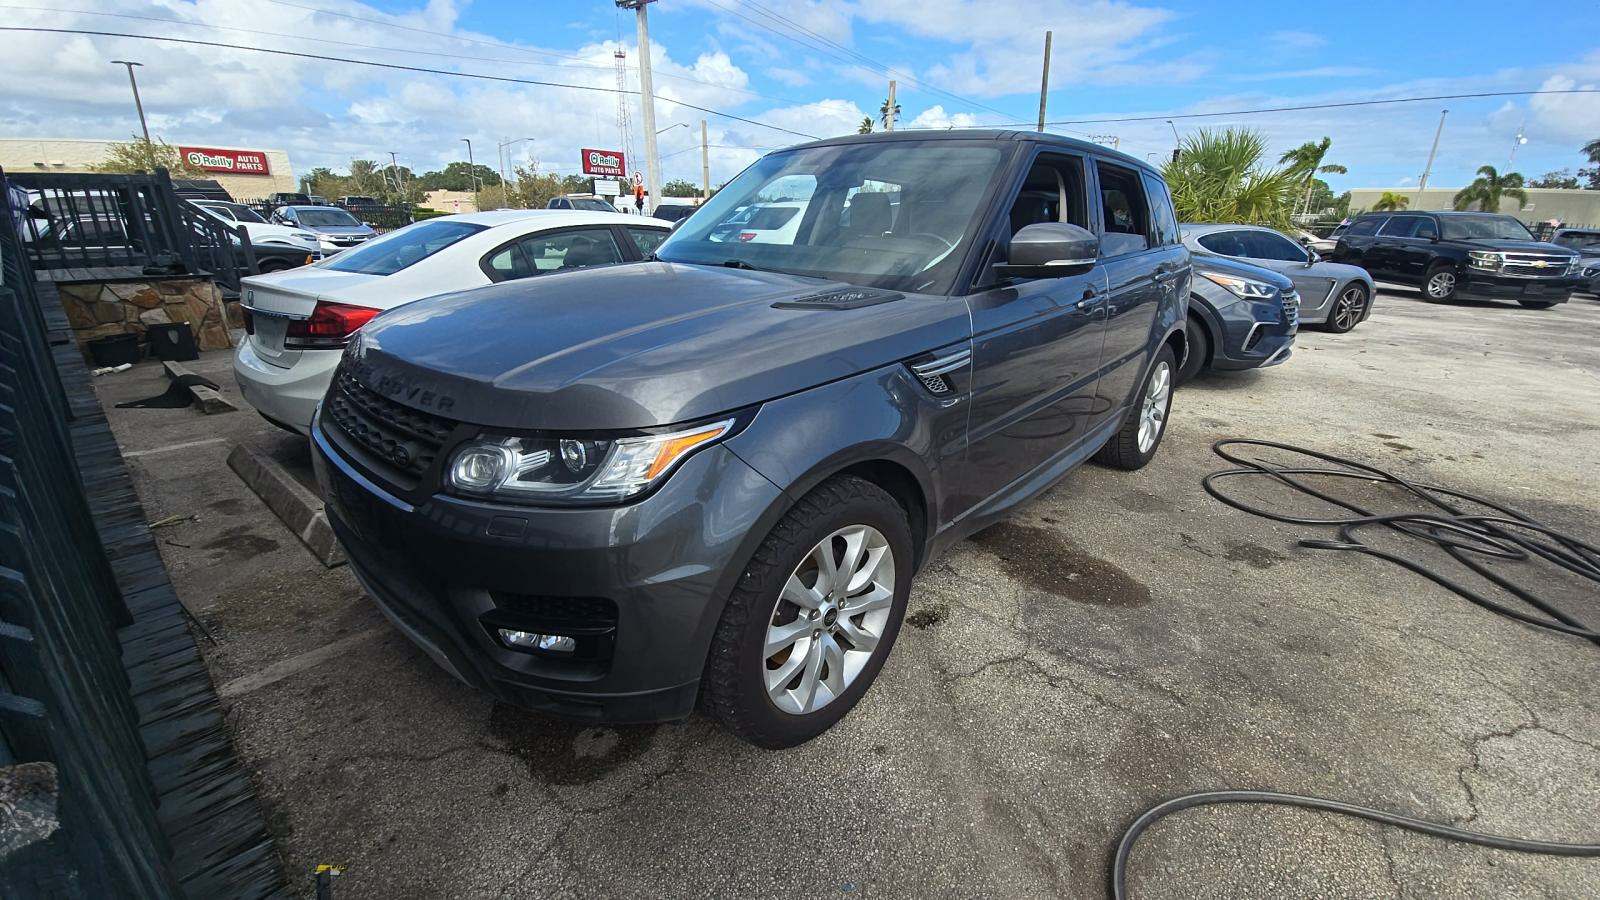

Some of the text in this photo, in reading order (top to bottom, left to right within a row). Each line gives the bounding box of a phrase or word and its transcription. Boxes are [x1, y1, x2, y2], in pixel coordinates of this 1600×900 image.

[188, 152, 233, 169] O'Reilly
[237, 155, 259, 163] AUTO
[589, 152, 620, 168] O'Reilly
[236, 162, 263, 171] PARTS
